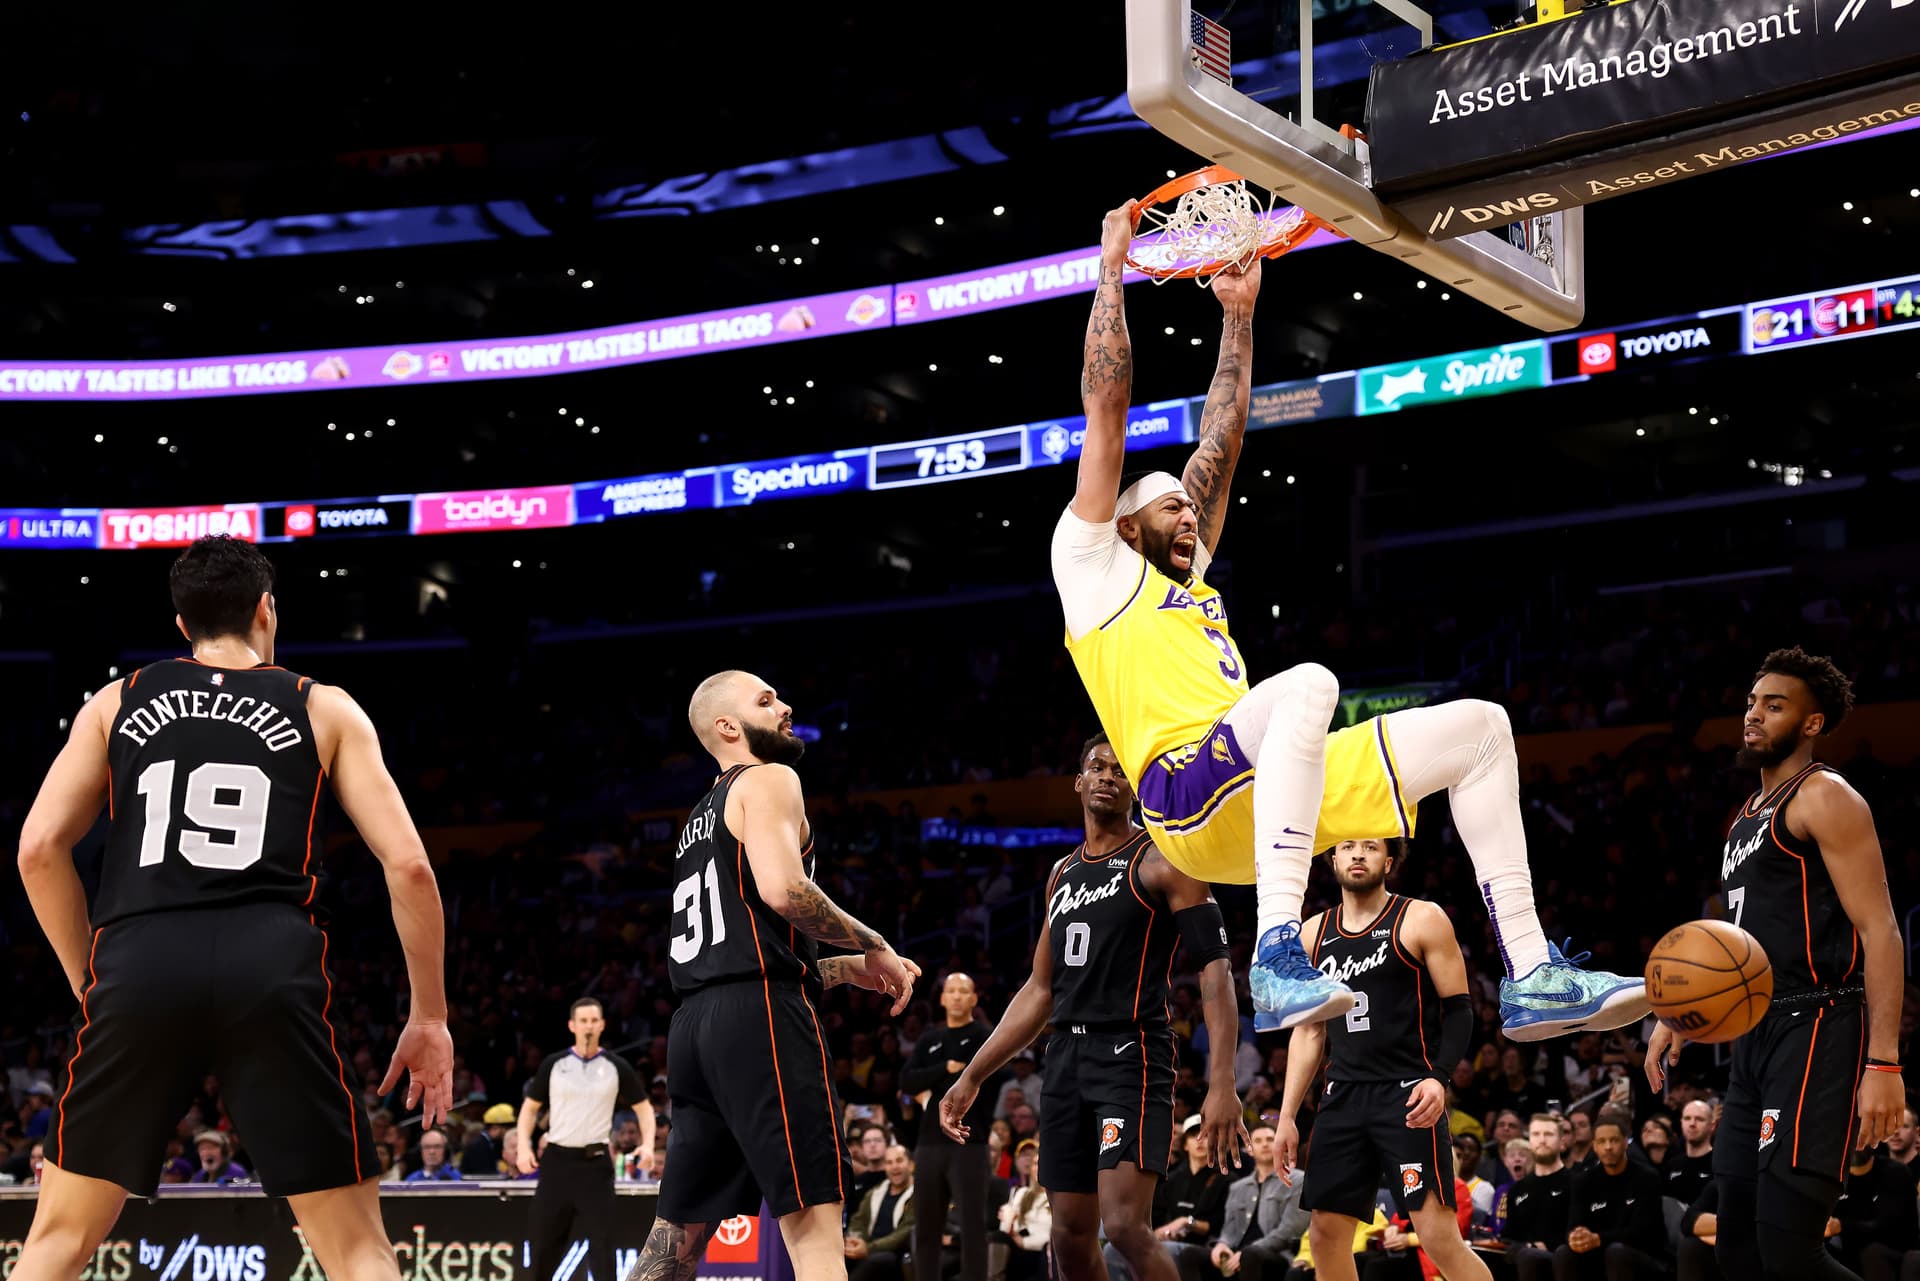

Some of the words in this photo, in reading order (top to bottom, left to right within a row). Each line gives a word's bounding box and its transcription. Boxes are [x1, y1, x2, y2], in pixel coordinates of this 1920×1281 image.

[1429, 69, 1531, 124] Asset
[1541, 3, 1801, 97] Management
[1461, 192, 1559, 224] DWS
[1587, 161, 1696, 196] Asset
[927, 270, 1029, 311] VICTORY
[1771, 307, 1804, 338] 21
[1834, 297, 1866, 329] 11
[461, 344, 565, 373] VICTORY
[567, 332, 647, 365] TASTES
[648, 322, 701, 352] LIKE
[699, 312, 774, 343] TACOS
[1620, 327, 1711, 359] TOYOTA
[84, 368, 175, 392] TASTES
[178, 364, 232, 391] LIKE
[233, 360, 308, 387] TACOS
[1440, 353, 1526, 396] Sprite
[732, 458, 849, 498] Spectrum
[915, 440, 987, 477] 7:53
[442, 494, 547, 525] boldyn
[602, 477, 686, 502] AMERICAN
[613, 491, 687, 515] EXPRESS
[22, 519, 93, 538] ULTRA
[107, 511, 252, 544] TOSHIBA
[318, 508, 388, 528] TOYOTA
[1203, 625, 1241, 681] 3
[118, 690, 302, 752] FONTECCHIO
[137, 759, 271, 871] 19
[669, 856, 725, 965] 31
[1048, 871, 1123, 928] Detroit
[1727, 886, 1745, 928] 7
[1064, 922, 1091, 966] 0
[1371, 928, 1391, 938] UWM
[1318, 940, 1389, 982] Detroit
[1345, 991, 1371, 1032] 2
[138, 1238, 164, 1271] by
